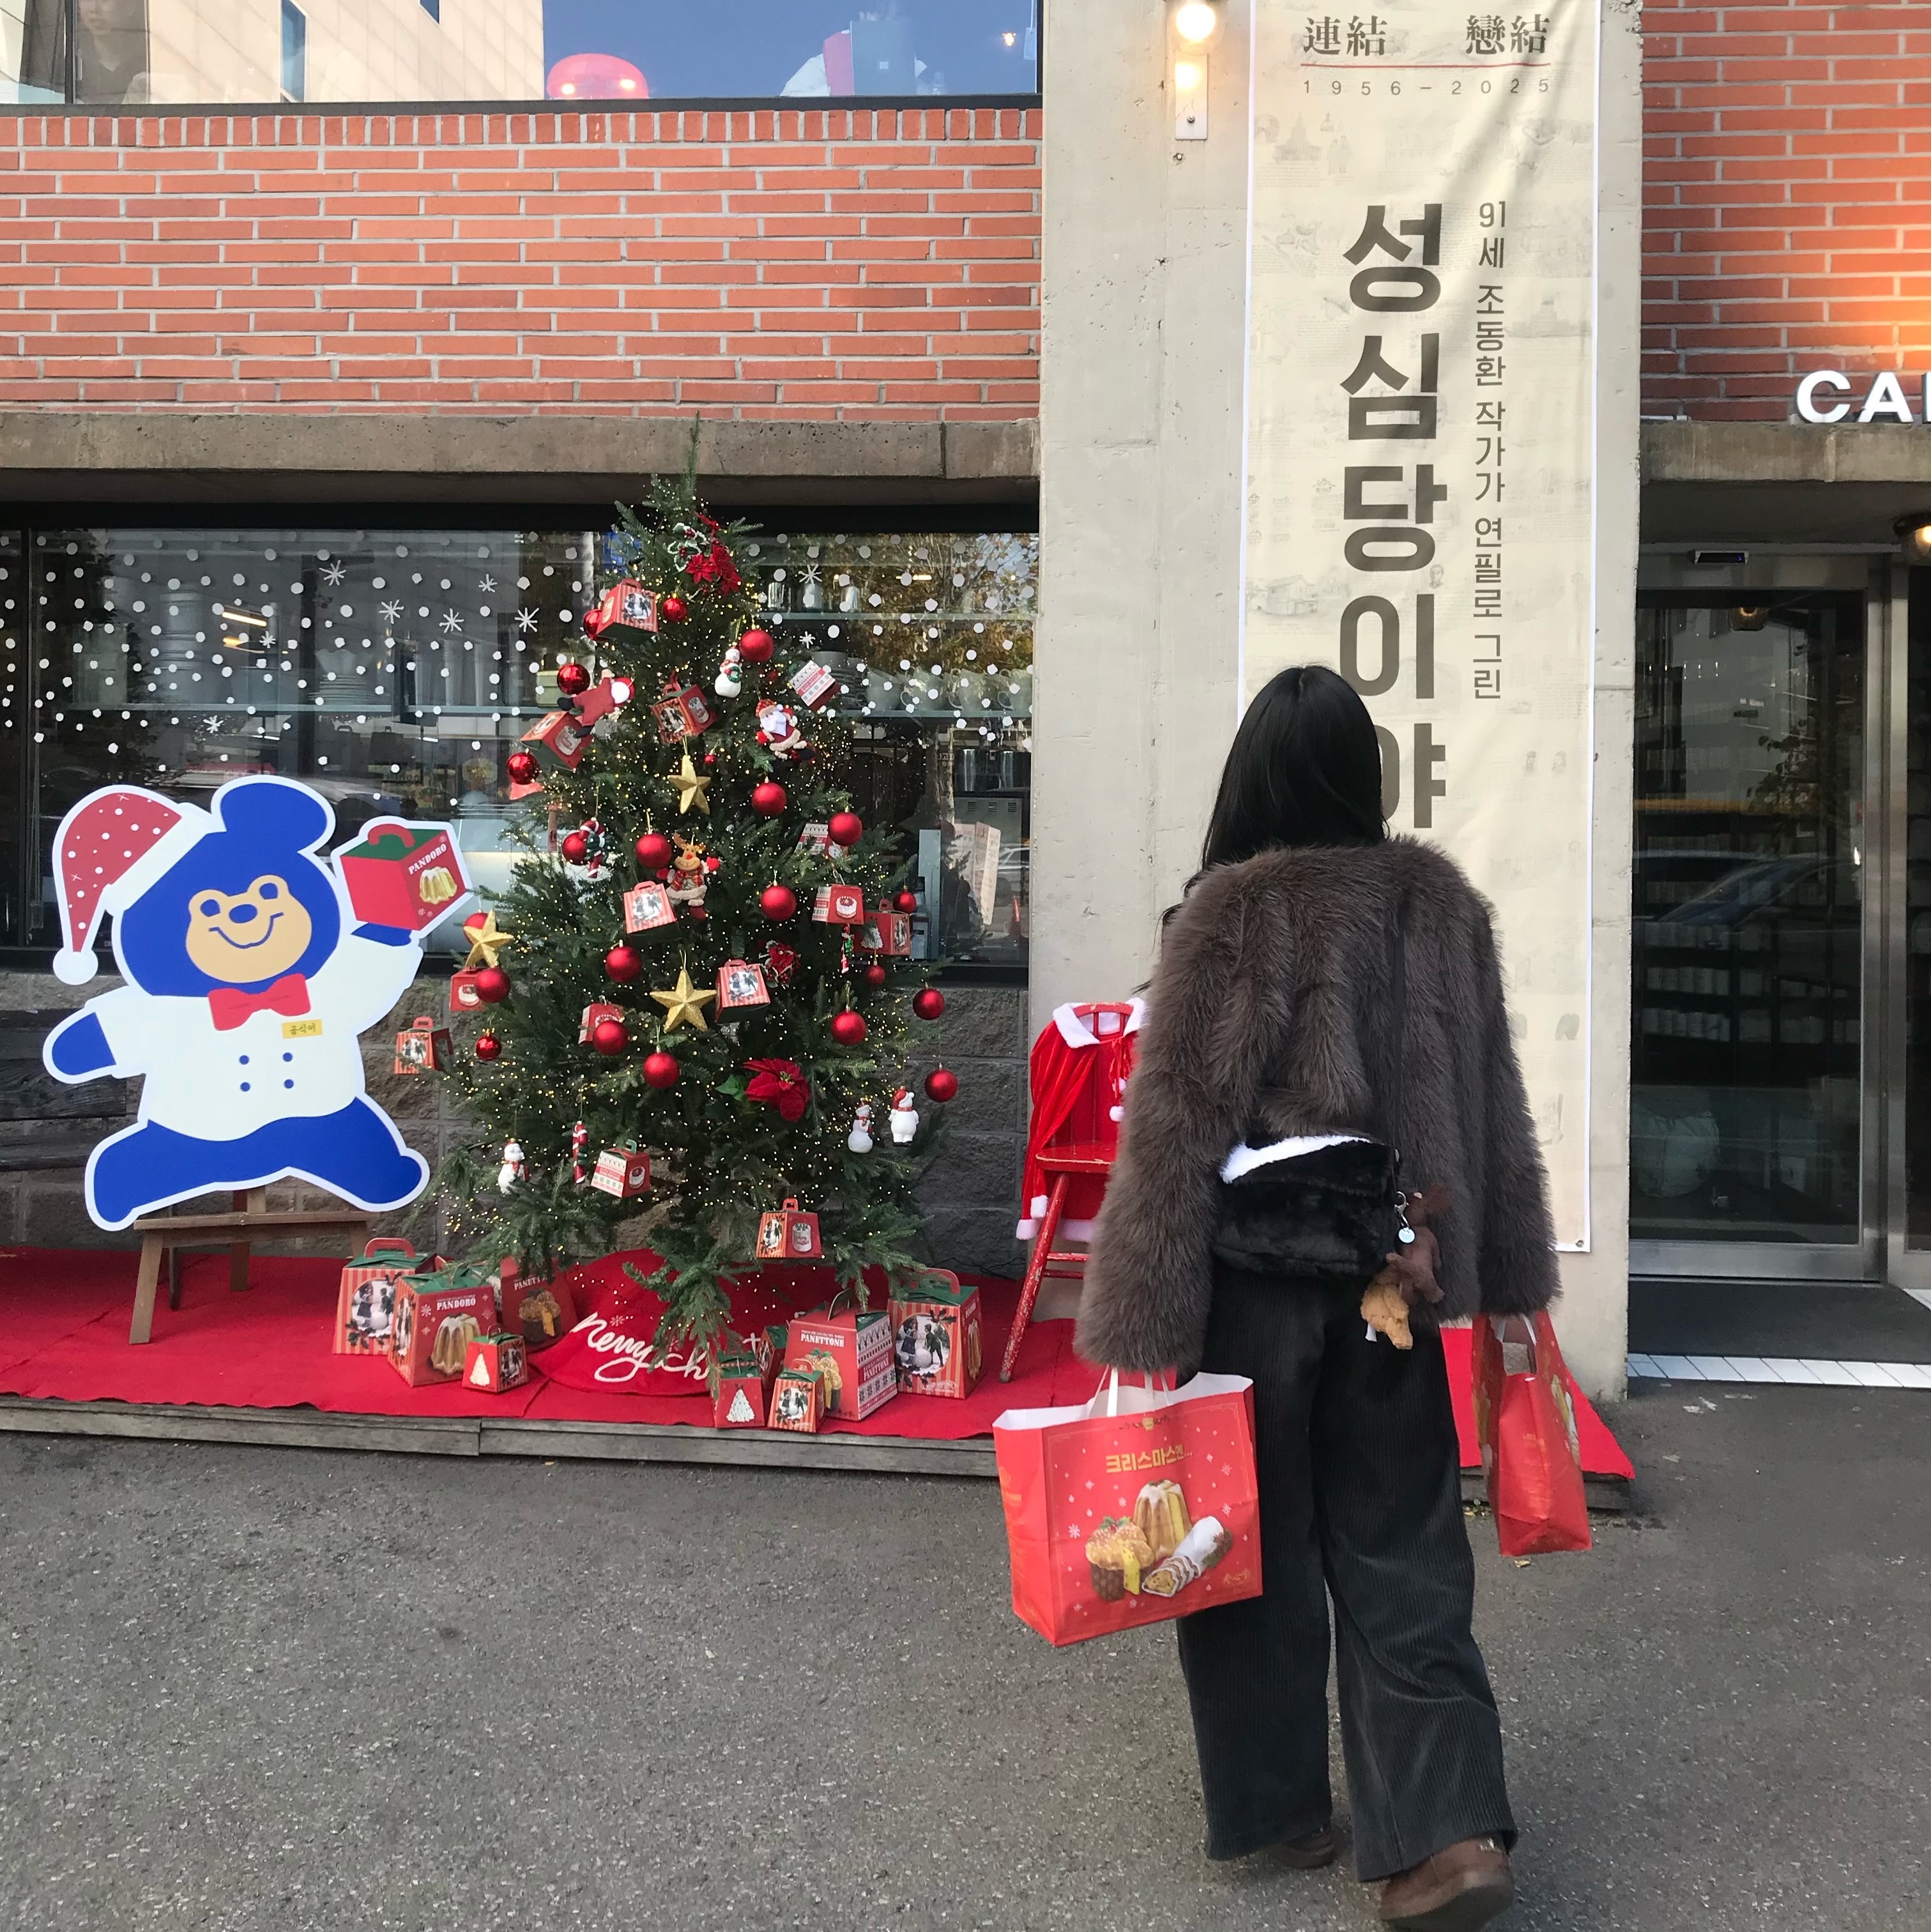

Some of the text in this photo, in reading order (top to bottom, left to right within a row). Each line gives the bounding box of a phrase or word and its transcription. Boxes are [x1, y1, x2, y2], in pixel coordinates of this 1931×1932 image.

[1302, 13, 1551, 57] 連結 戀結
[1796, 370, 1931, 423] CA
[1472, 201, 1506, 700] 91세 조동환 작가가 연필로 그린
[408, 843, 447, 875] PANDORO
[436, 1297, 477, 1311] PANDORO
[800, 1334, 844, 1348] PANETTONE
